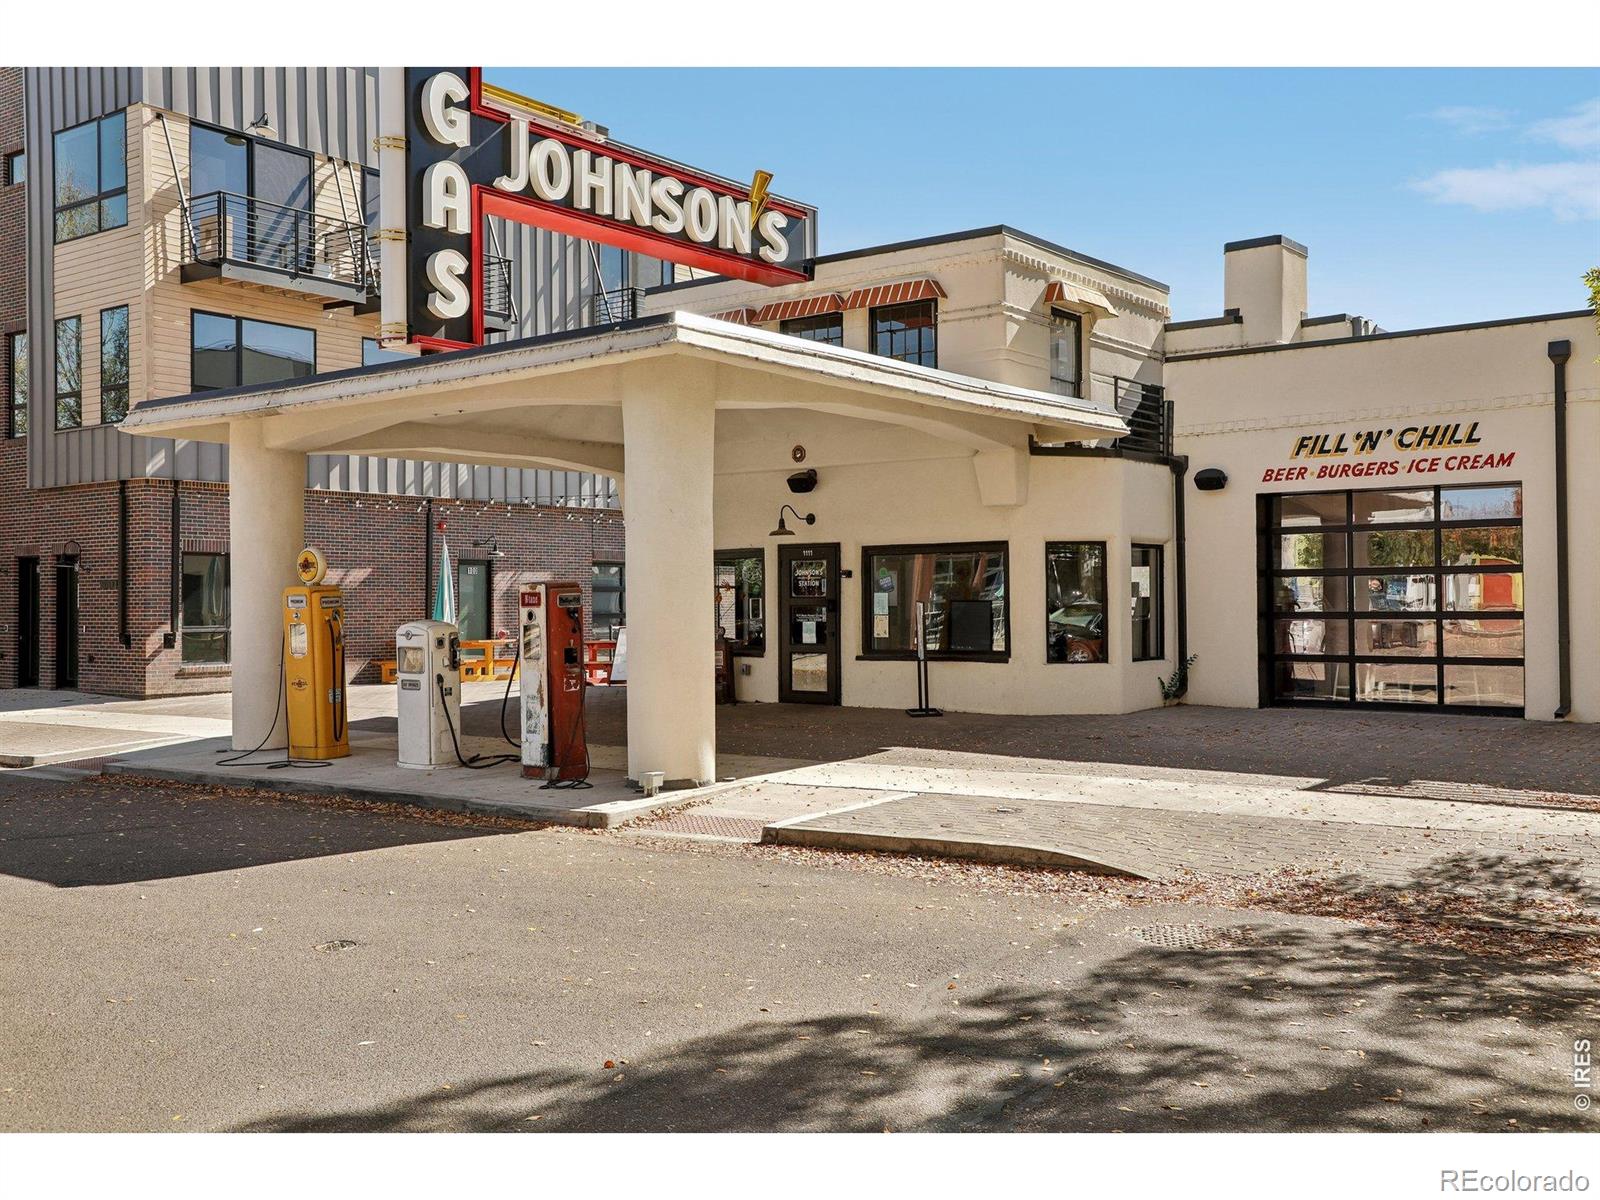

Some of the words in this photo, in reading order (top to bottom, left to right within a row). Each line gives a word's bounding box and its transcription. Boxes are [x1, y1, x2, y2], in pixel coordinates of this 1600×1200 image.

[420, 70, 472, 320] GAS
[1289, 432, 1348, 460] FILL
[1394, 421, 1482, 452] CHILL
[1261, 466, 1308, 483] BEER
[1316, 460, 1400, 479] BURGERS
[1406, 457, 1441, 474] ICE
[1444, 452, 1517, 471] CREAM
